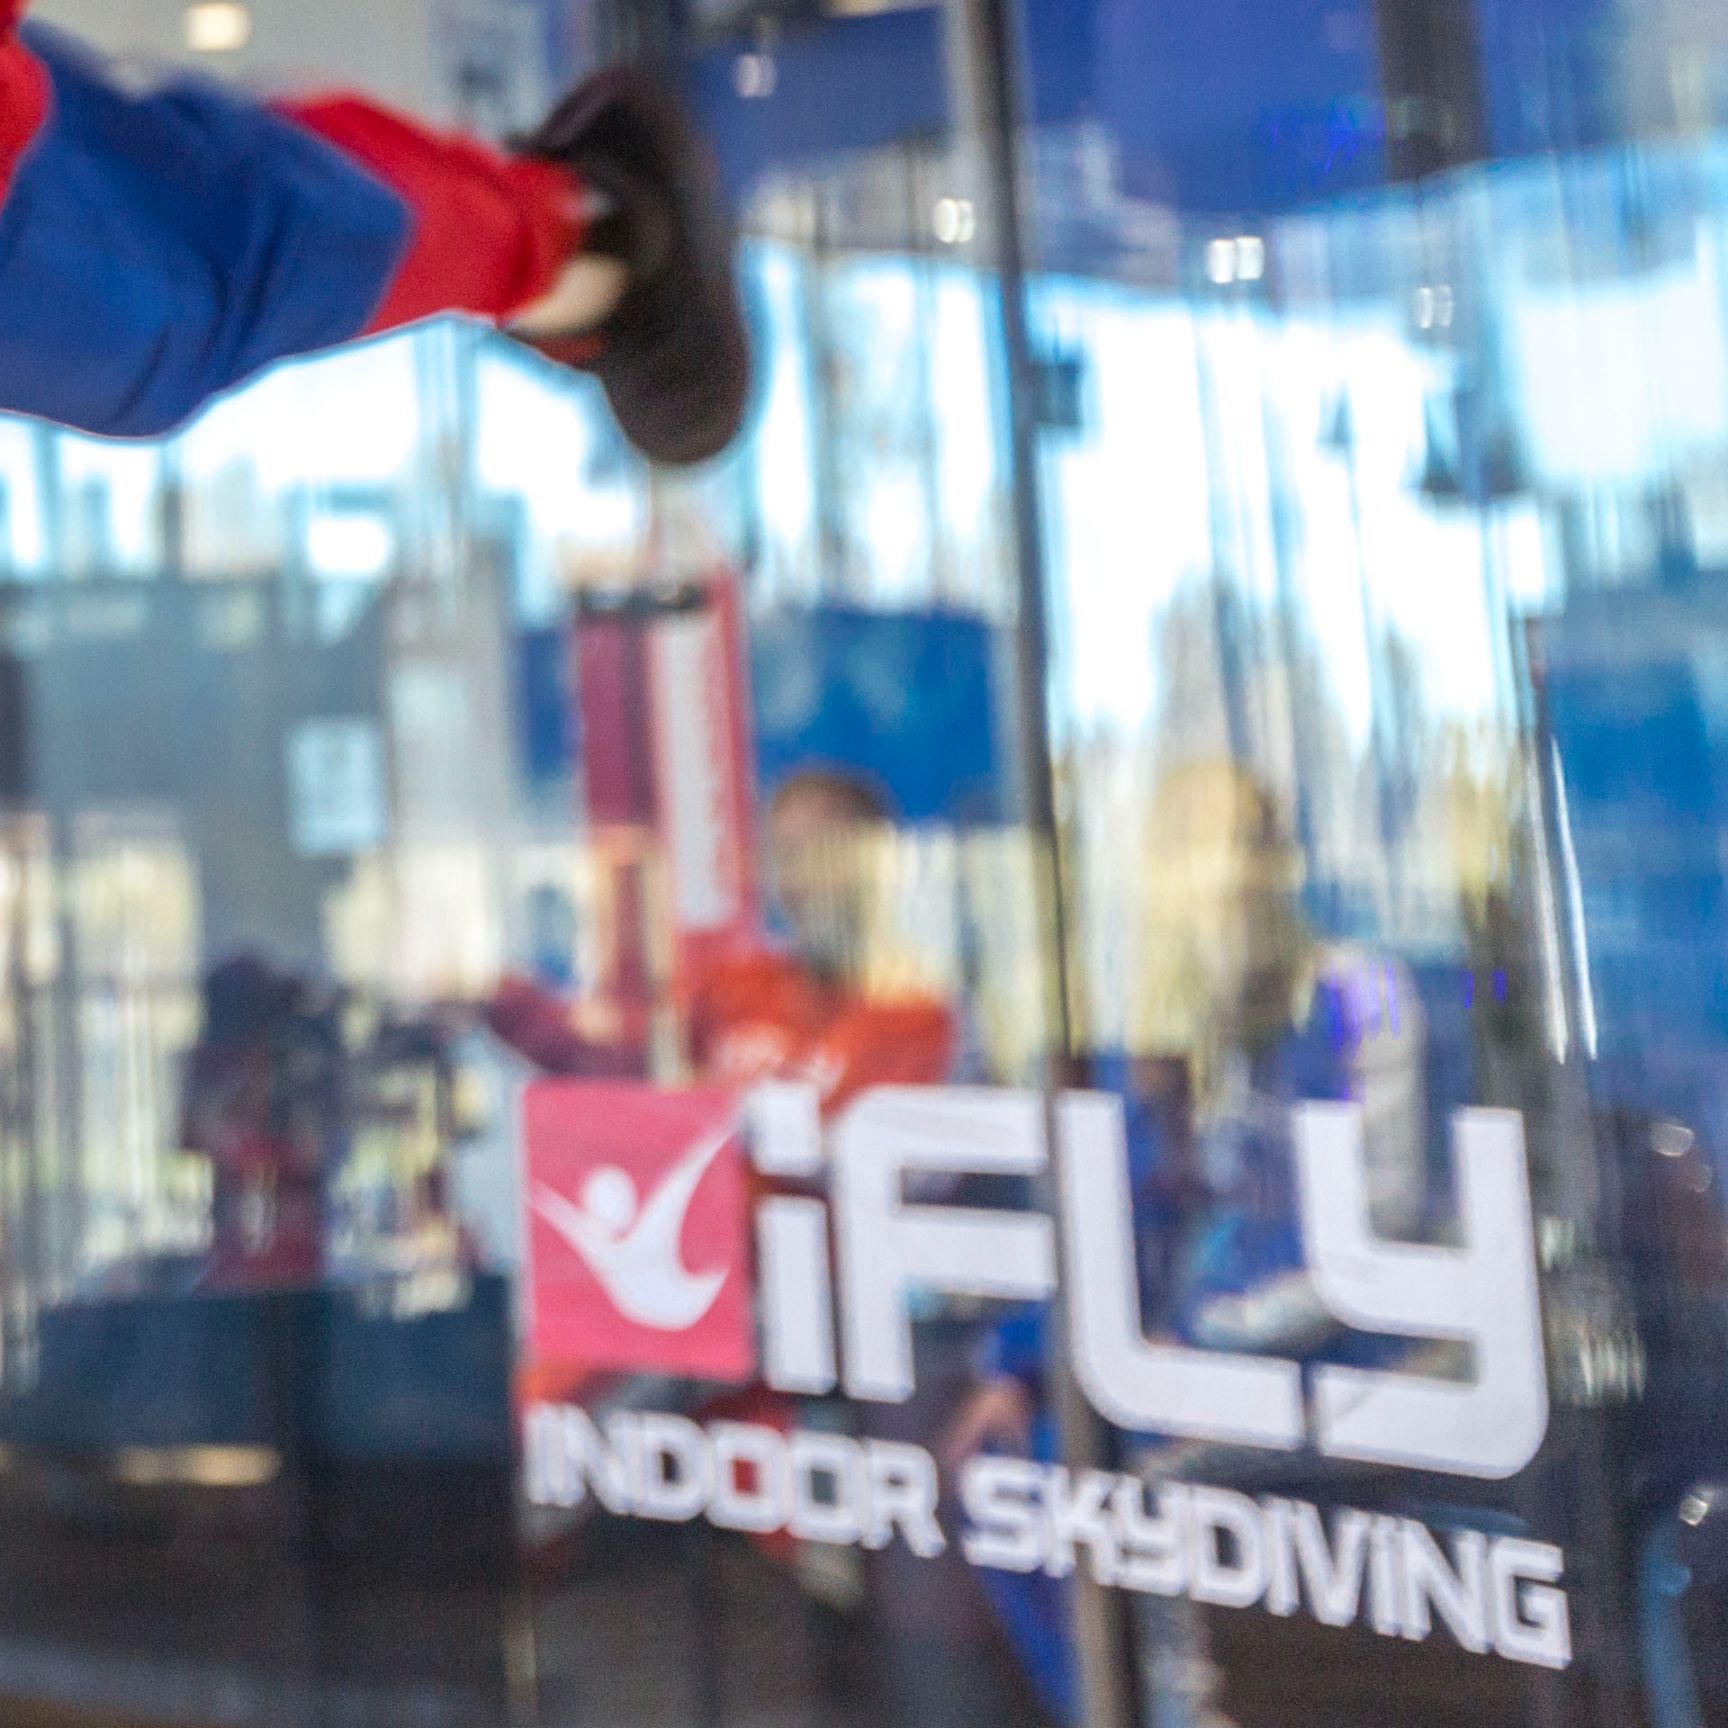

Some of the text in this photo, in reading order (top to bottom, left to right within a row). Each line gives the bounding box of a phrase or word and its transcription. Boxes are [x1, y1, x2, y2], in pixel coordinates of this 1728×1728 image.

[746, 1080, 1549, 1480] iFLY
[525, 1400, 1574, 1671] INDOOR SKYDIVING
